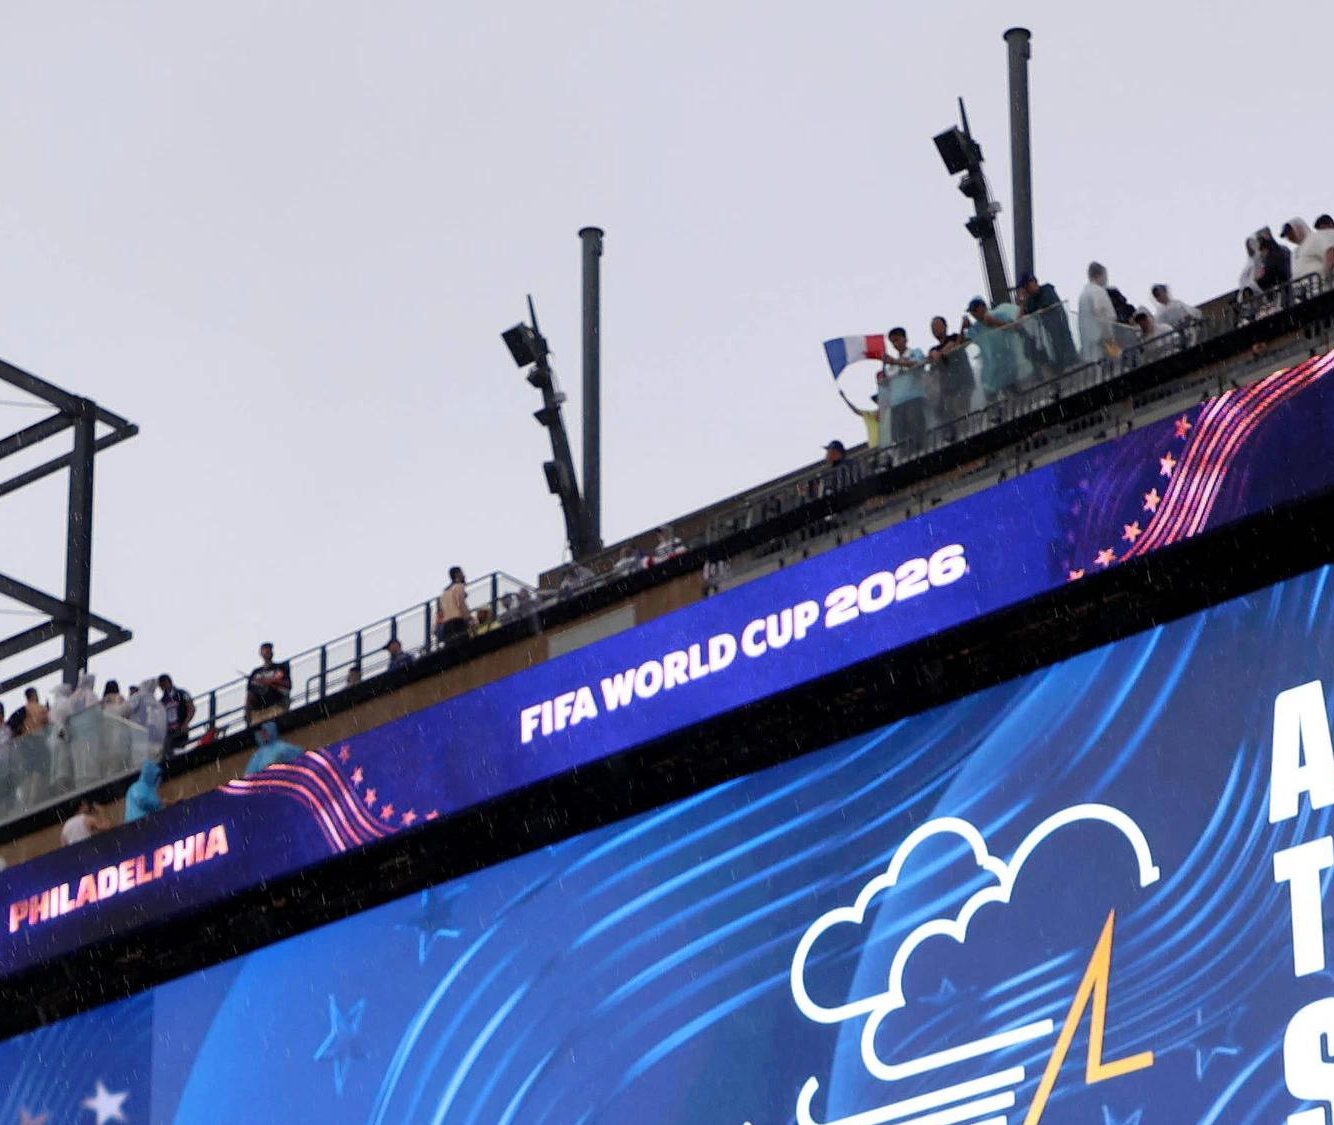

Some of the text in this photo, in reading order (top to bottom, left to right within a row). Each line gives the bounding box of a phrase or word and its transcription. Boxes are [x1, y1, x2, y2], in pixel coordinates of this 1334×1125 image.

[520, 543, 967, 744] FIFA WORLD CUP 2026
[9, 824, 229, 933] PHILADELPHIA
